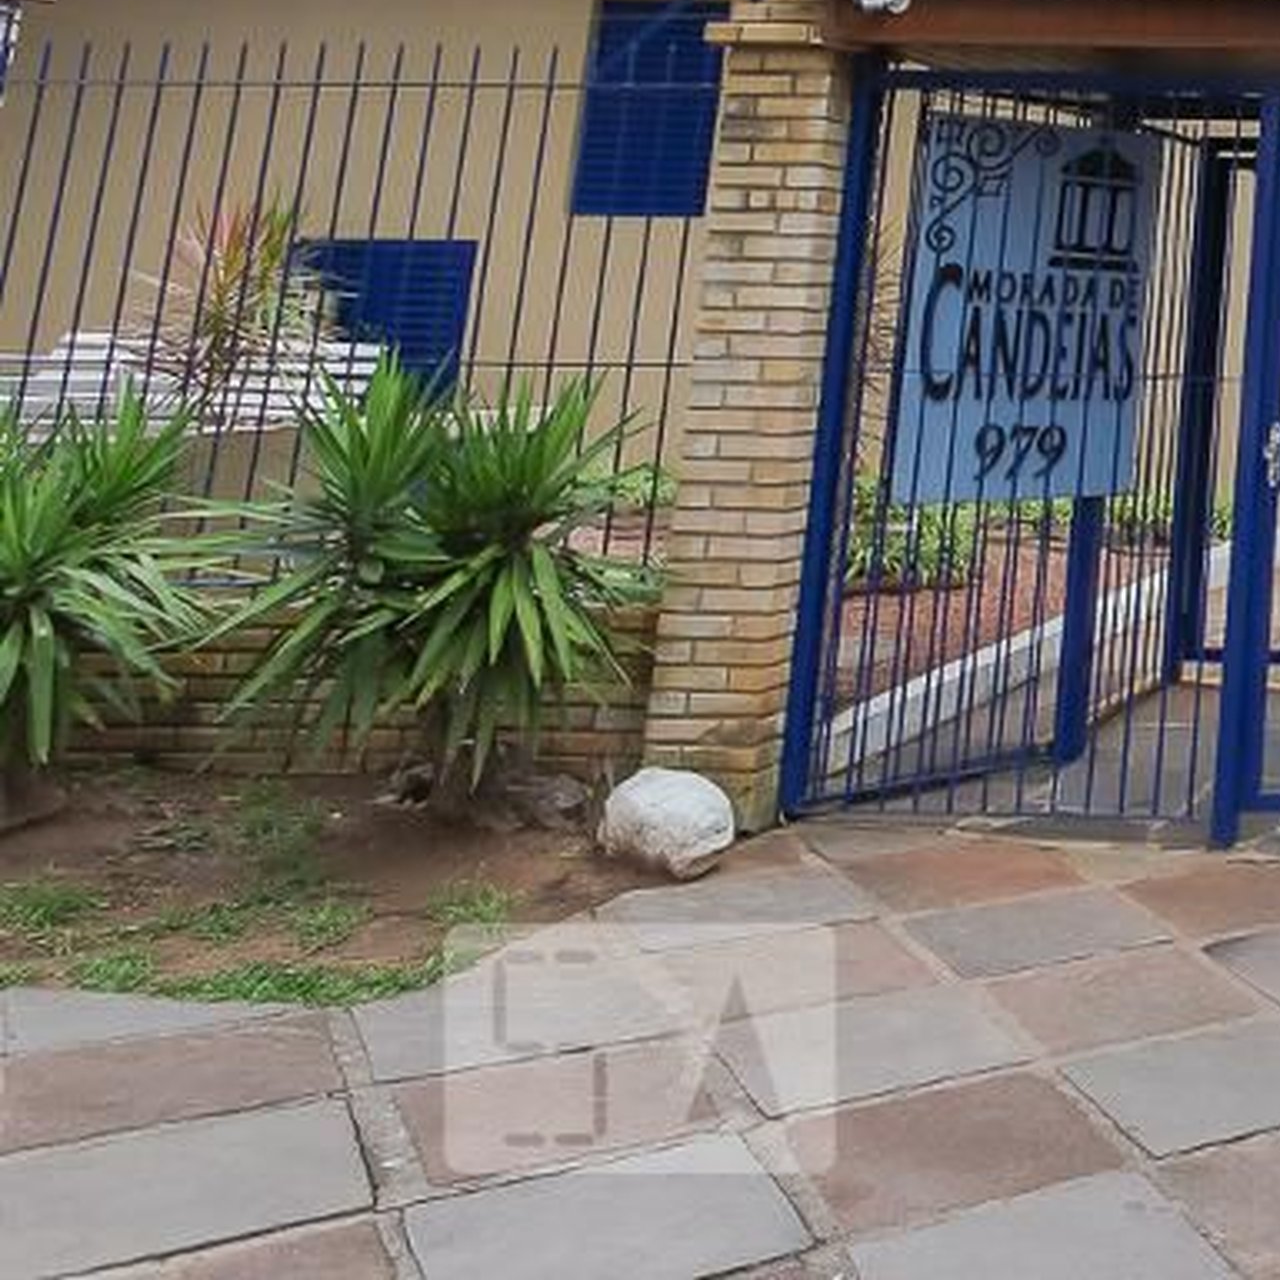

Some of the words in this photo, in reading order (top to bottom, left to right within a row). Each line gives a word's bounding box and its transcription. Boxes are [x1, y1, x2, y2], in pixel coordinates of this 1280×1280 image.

[967, 269, 1098, 308] MORADA
[1108, 277, 1141, 312] DE
[919, 263, 1138, 404] CANDEIAS
[973, 423, 1067, 480] 979
